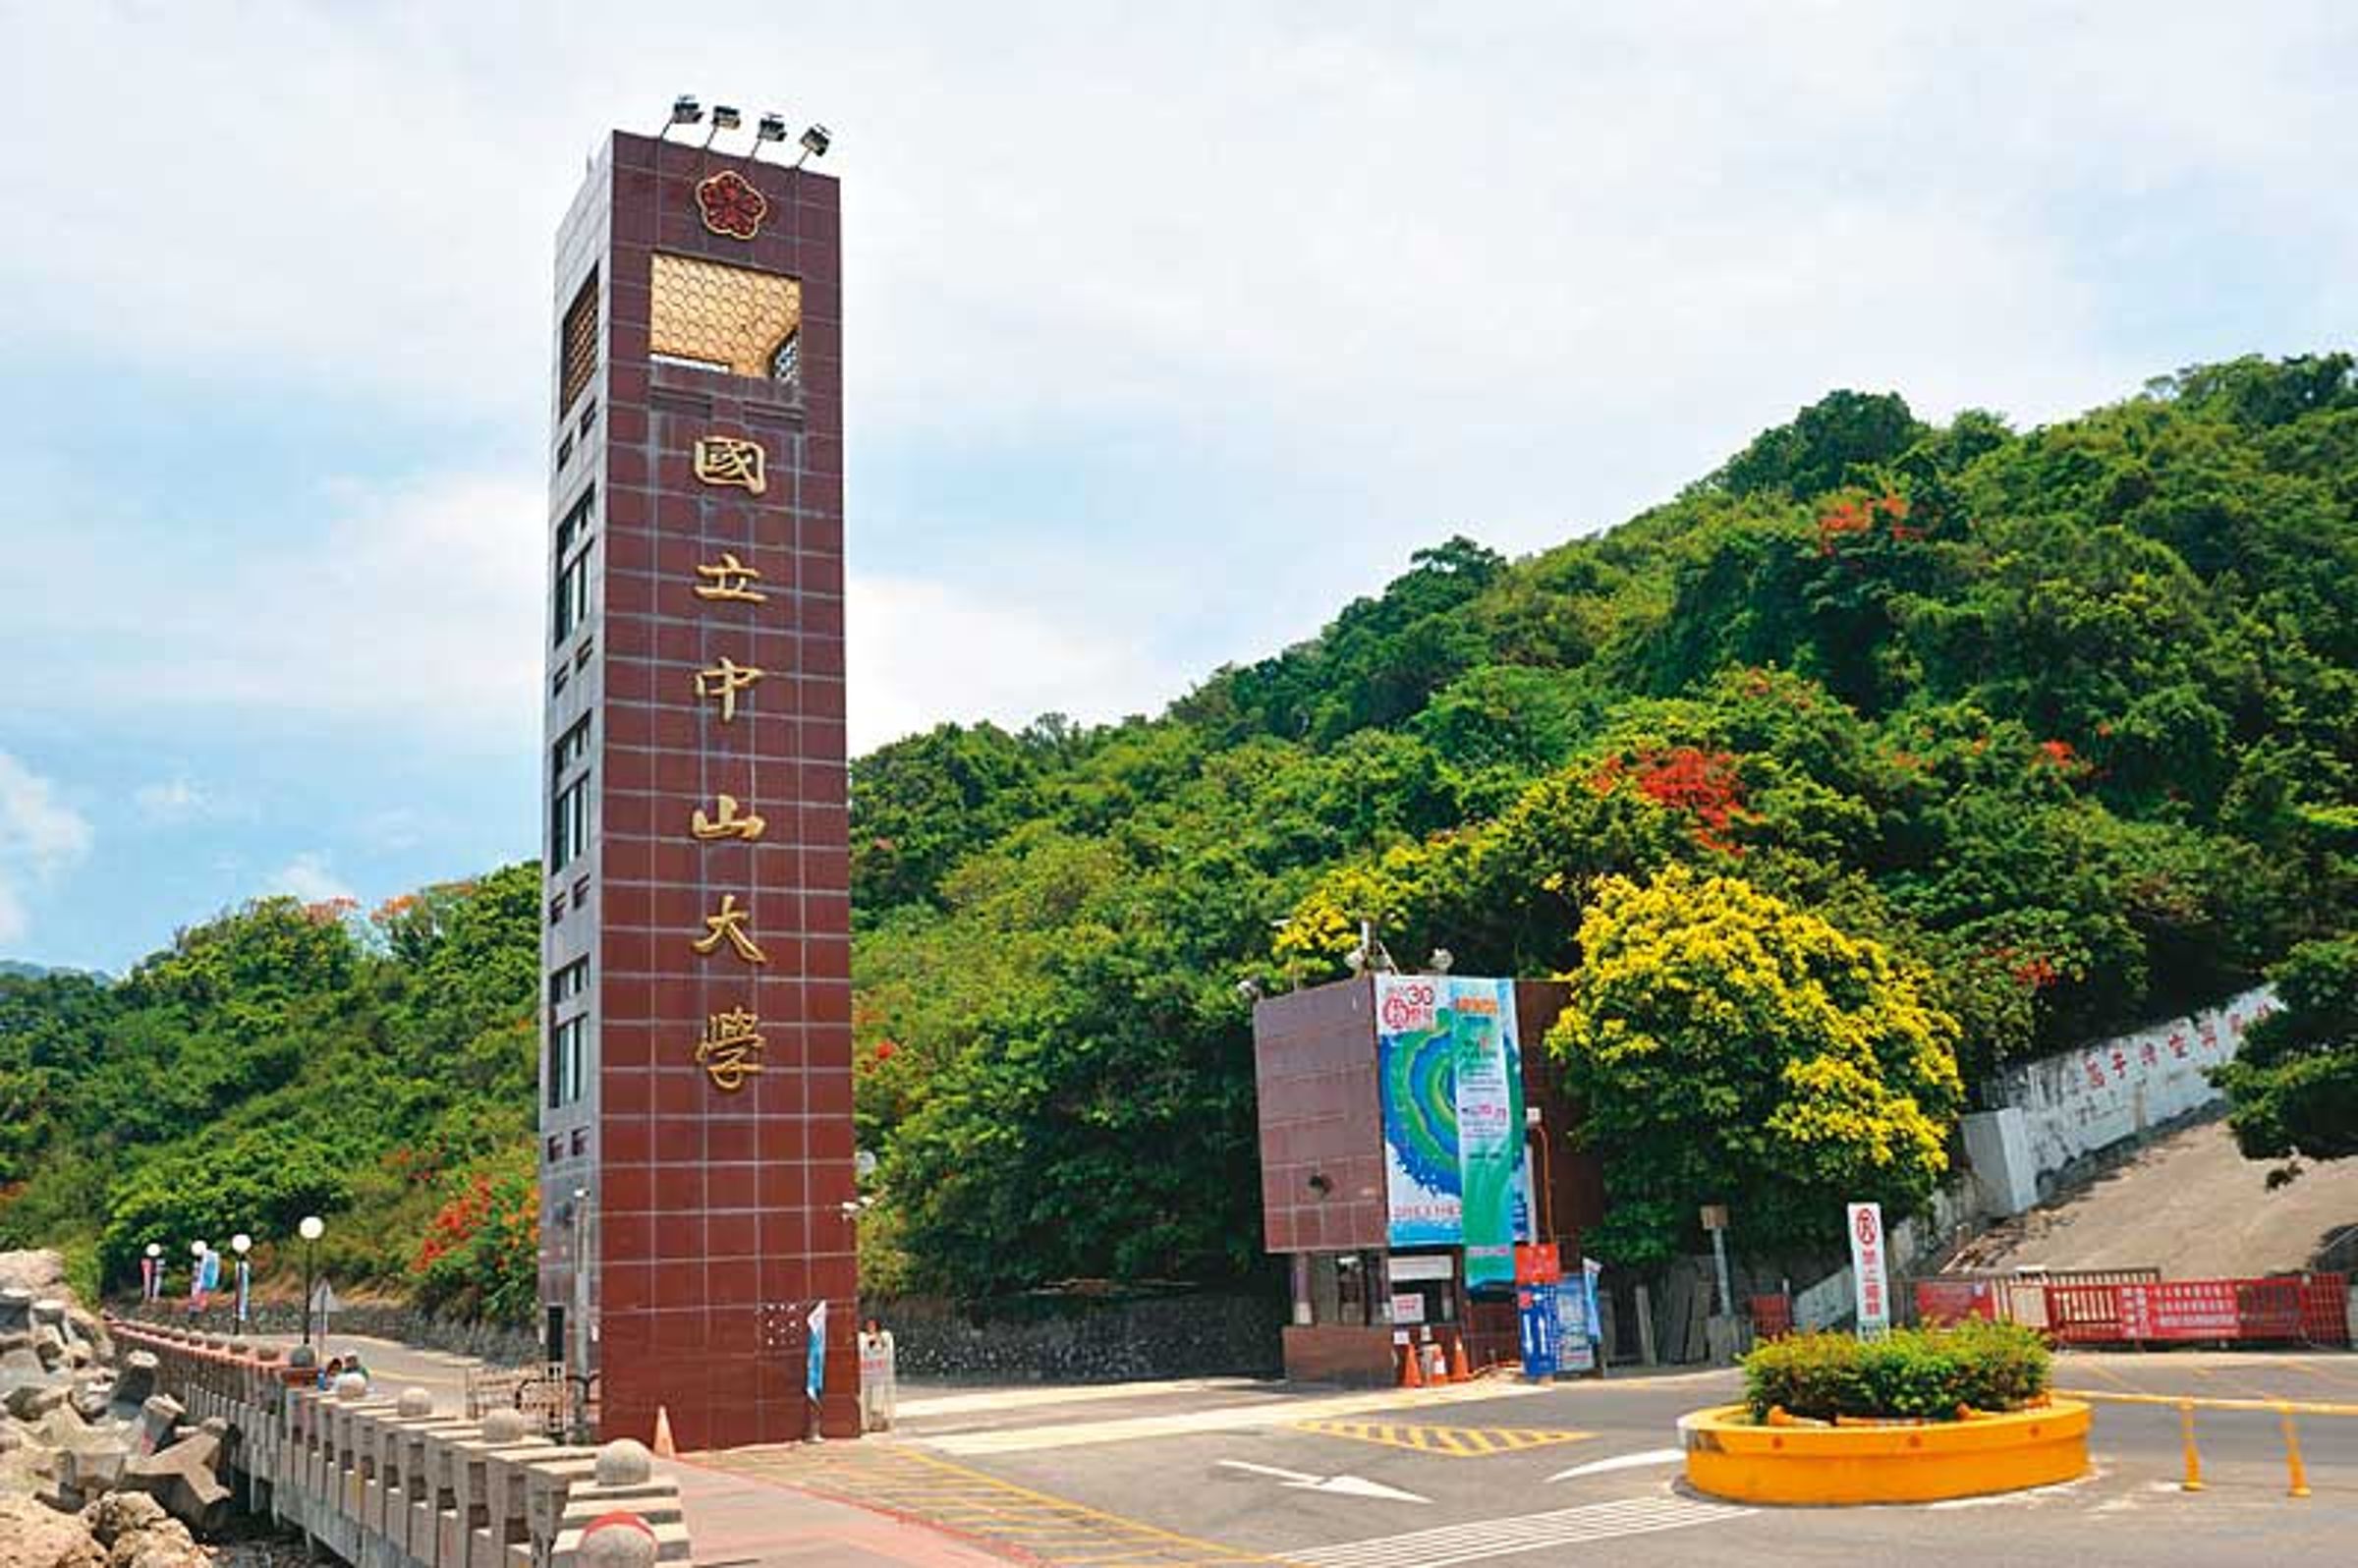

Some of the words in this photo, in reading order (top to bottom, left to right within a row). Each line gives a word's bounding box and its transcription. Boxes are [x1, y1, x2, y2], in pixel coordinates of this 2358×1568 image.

[692, 435, 767, 1091] 國立中山大學
